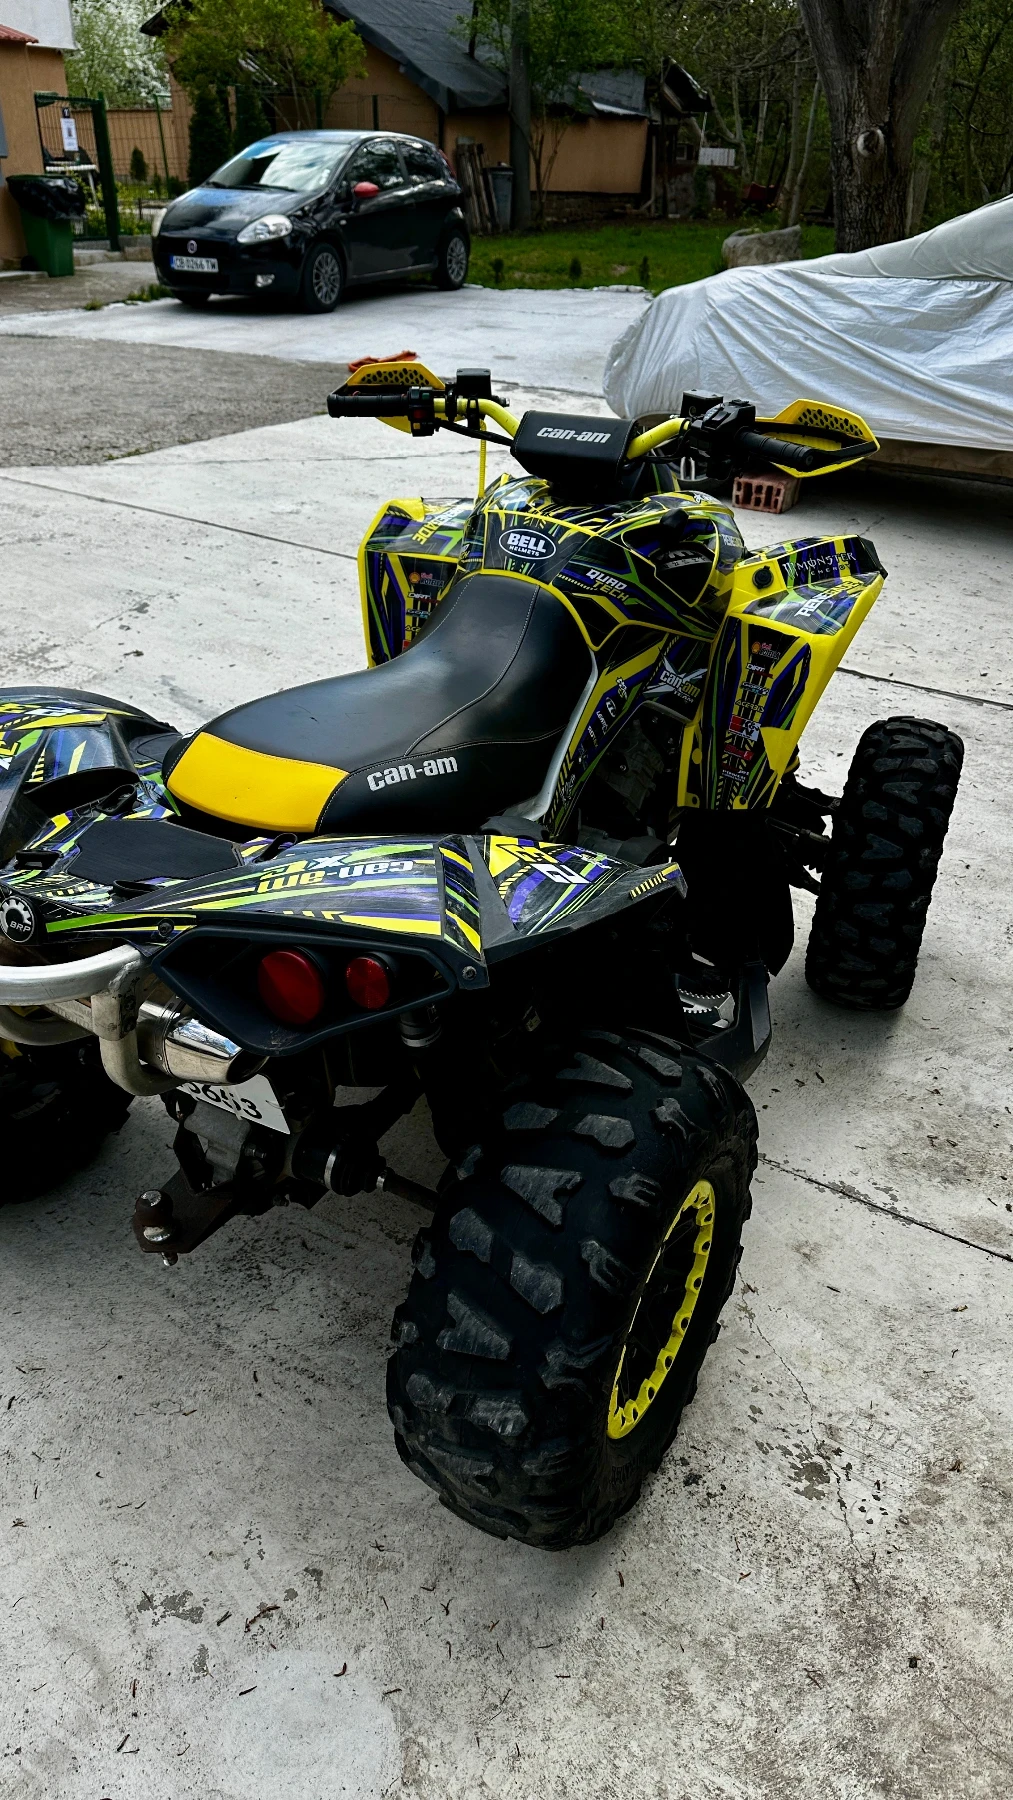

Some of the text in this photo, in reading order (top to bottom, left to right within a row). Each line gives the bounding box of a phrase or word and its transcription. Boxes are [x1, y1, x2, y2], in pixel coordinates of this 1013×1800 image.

[536, 427, 612, 443] can-am
[507, 533, 547, 553] BELL
[508, 545, 540, 557] HELMETS
[585, 568, 628, 591] QUAD
[592, 579, 630, 601] TECH
[660, 671, 700, 698] can-am
[366, 756, 459, 791] can-am
[257, 860, 414, 894] can-am
[9, 920, 31, 933] BRP
